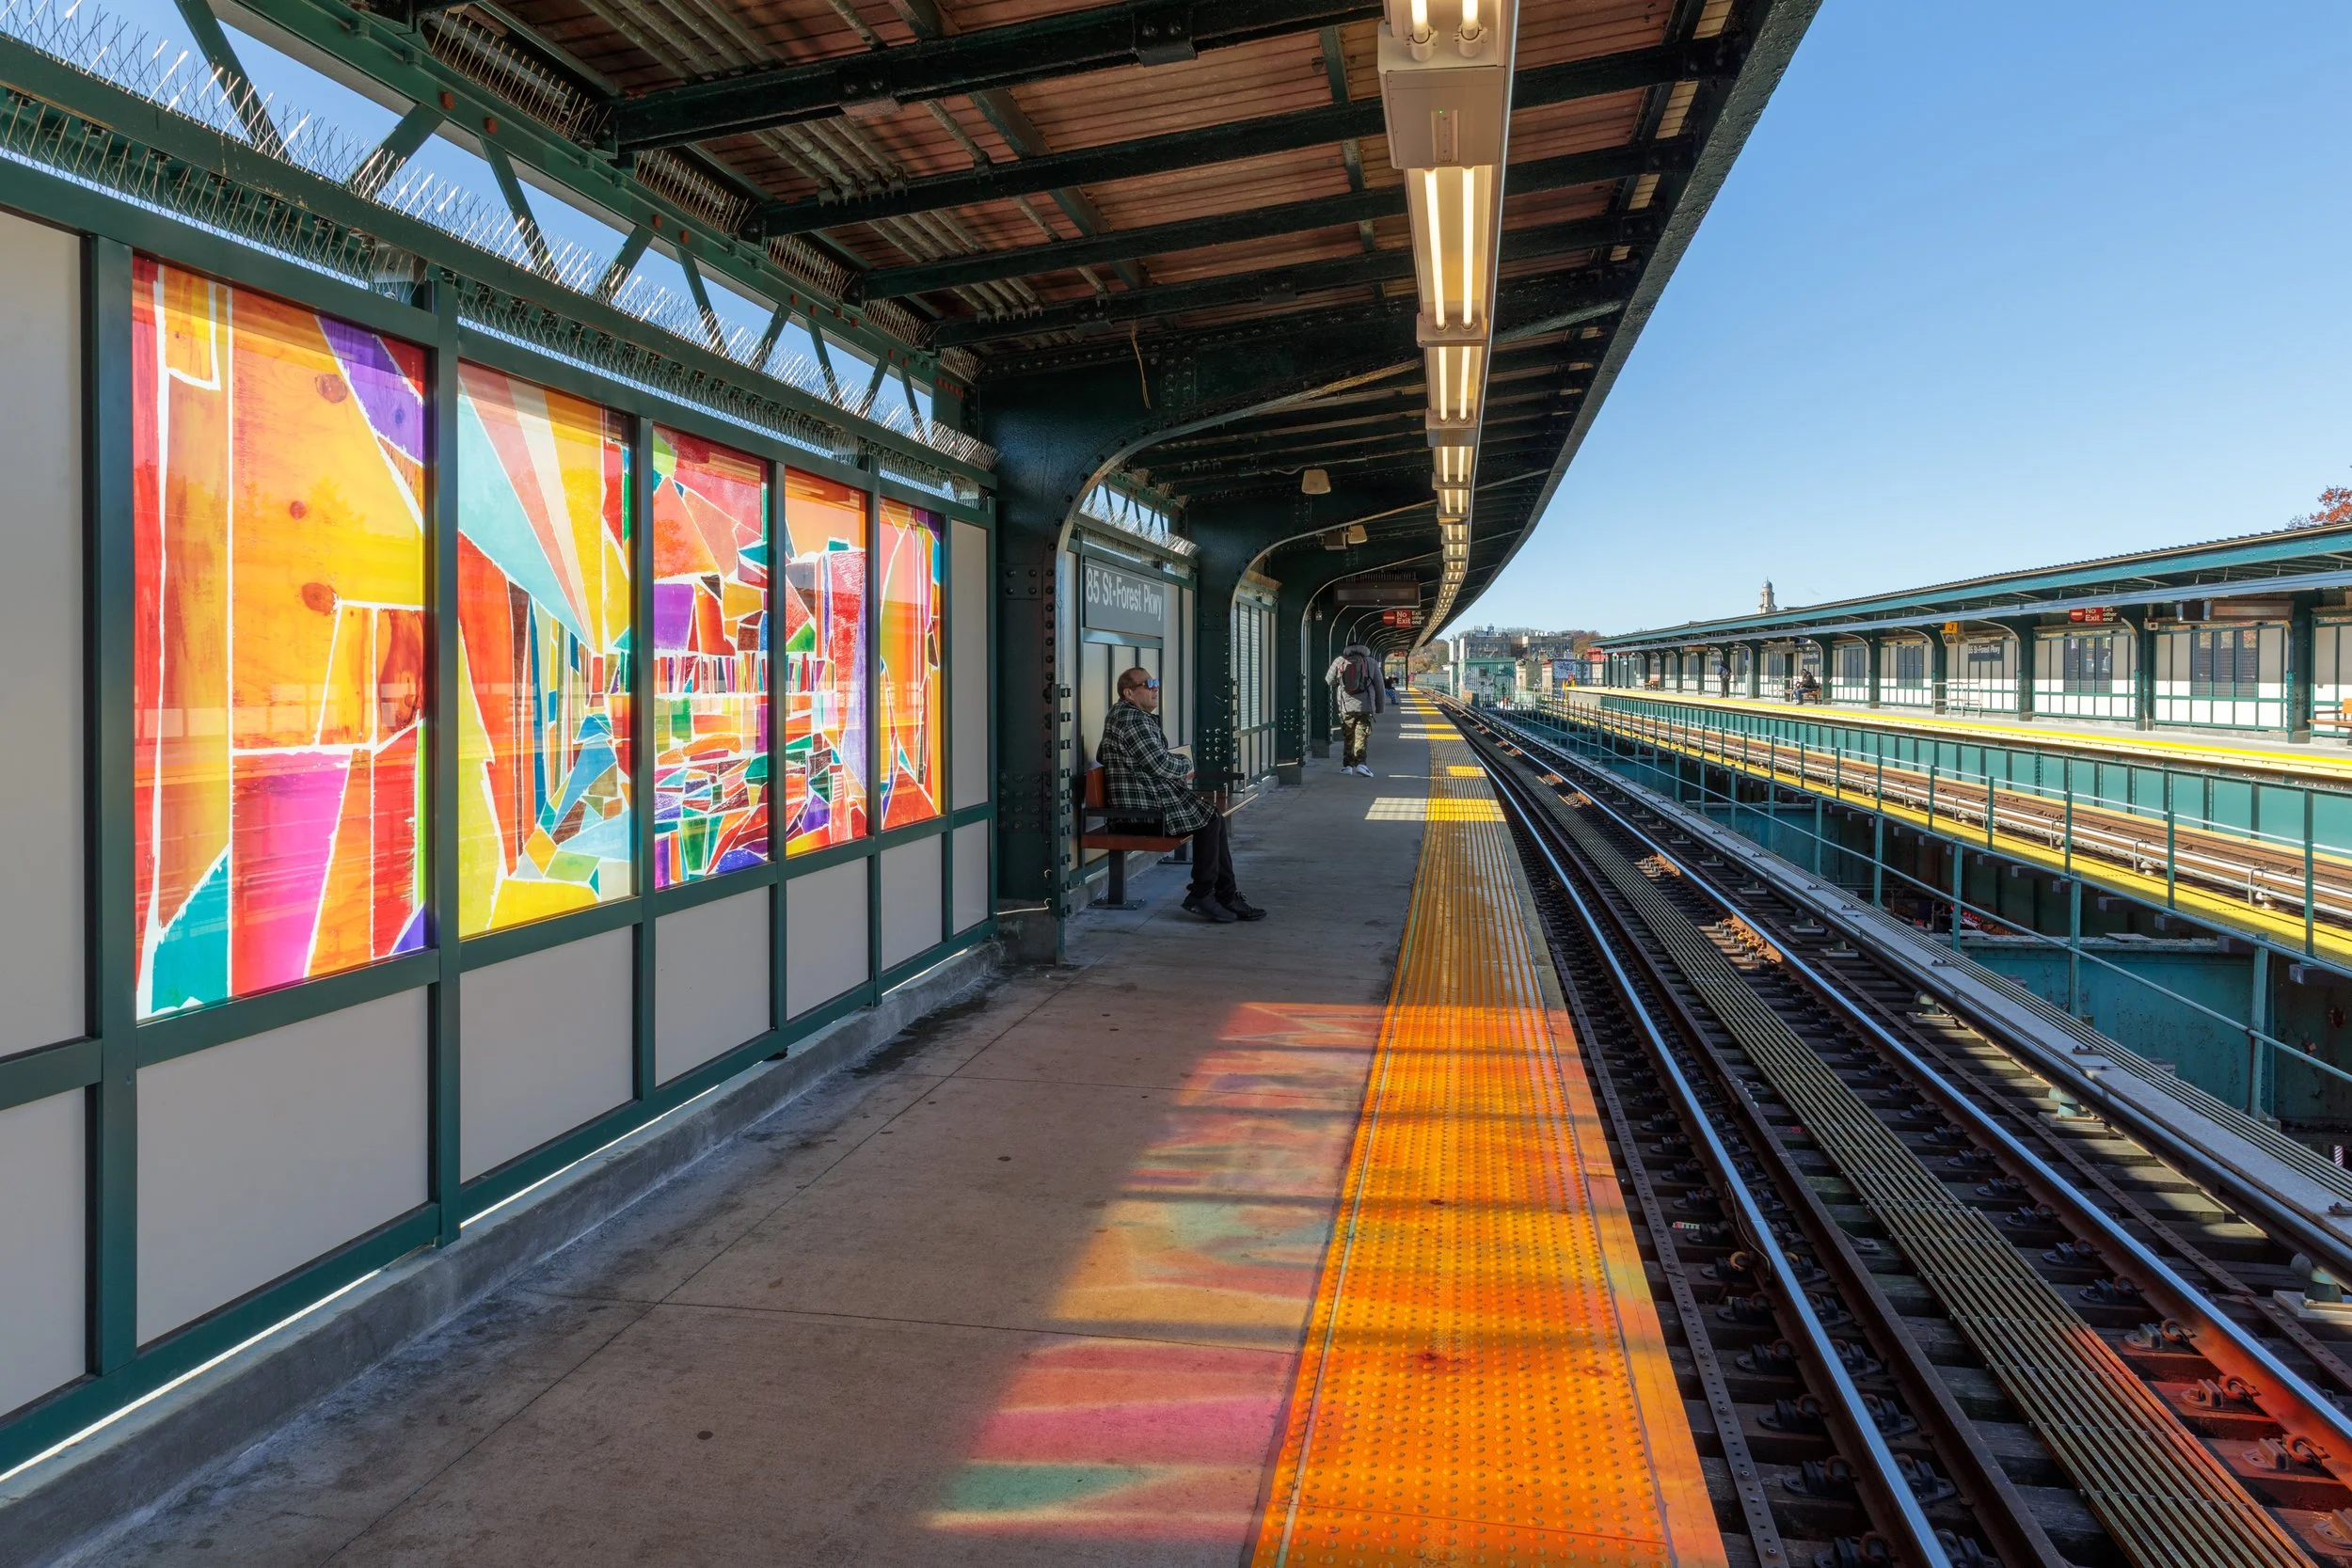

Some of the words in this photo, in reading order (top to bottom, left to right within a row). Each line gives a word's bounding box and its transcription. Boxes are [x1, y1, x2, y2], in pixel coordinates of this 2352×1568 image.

[1086, 567, 1100, 604] 85
[1103, 571, 1141, 612] St-Forest
[1143, 583, 1163, 622] Pkwy
